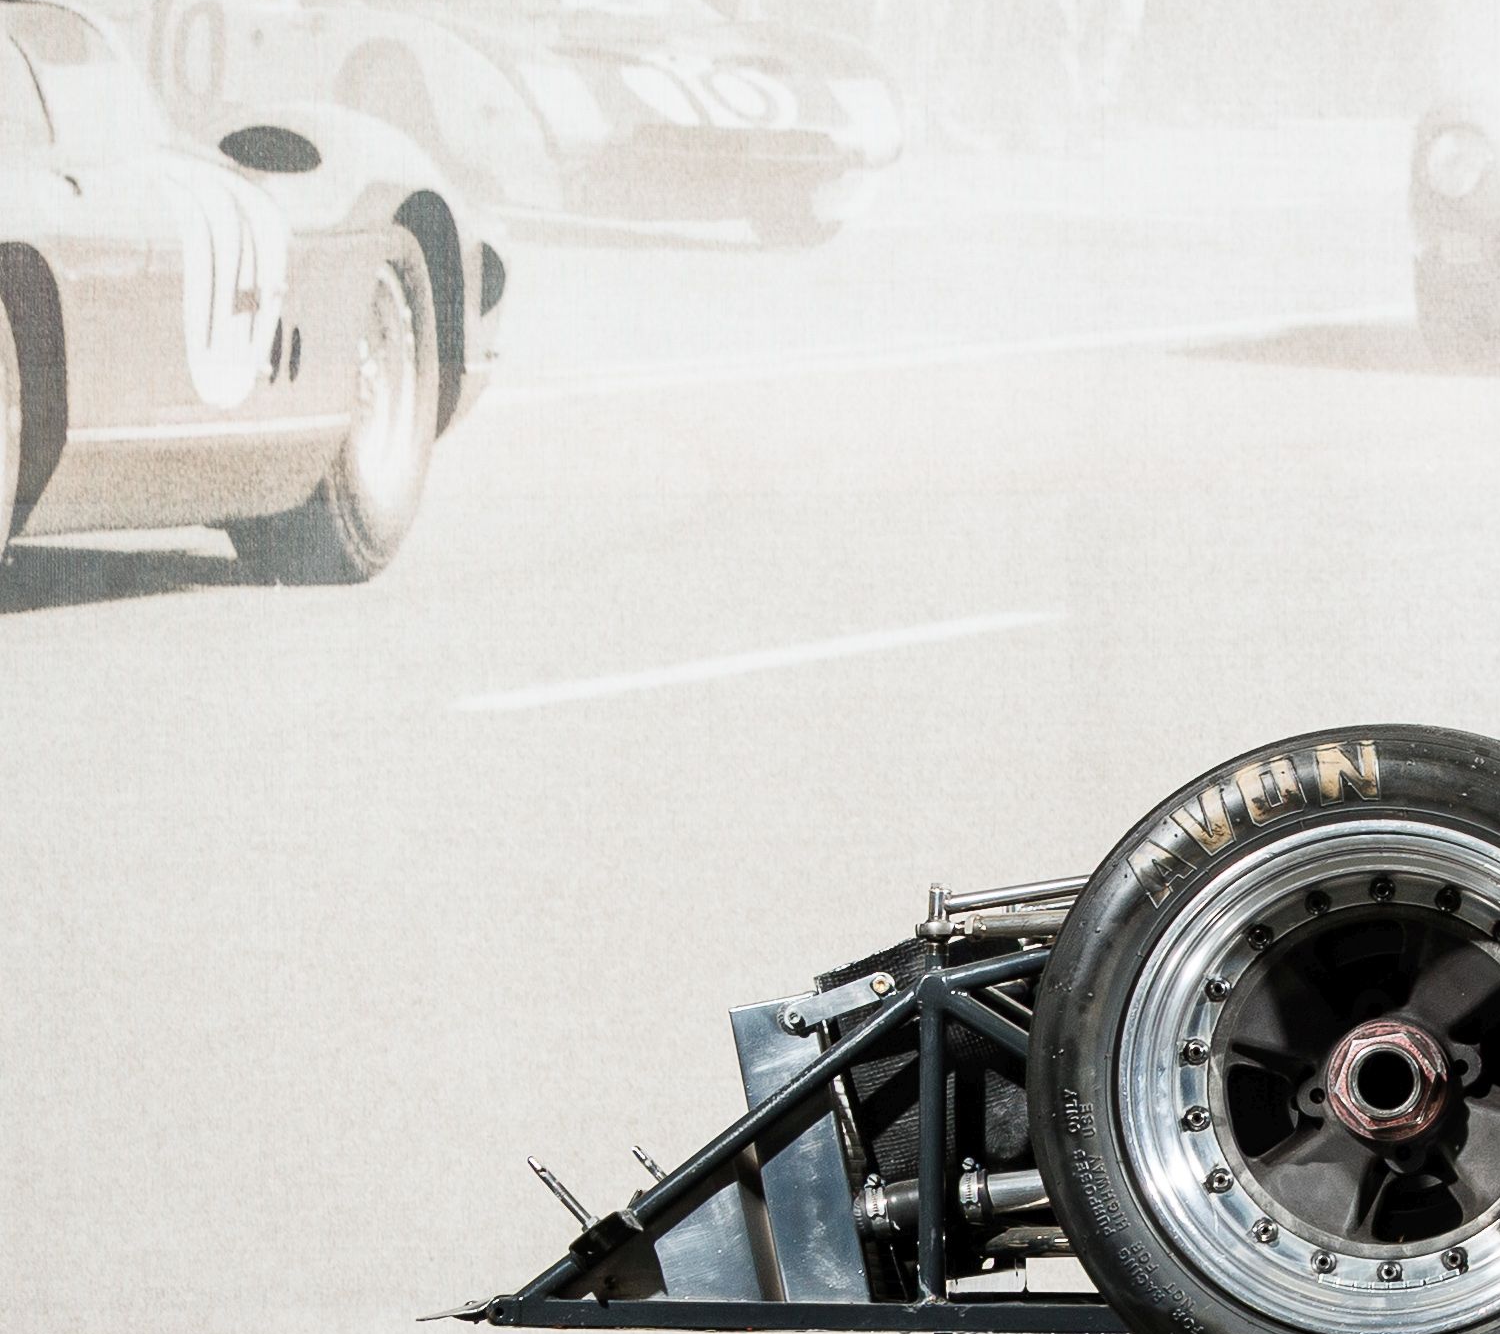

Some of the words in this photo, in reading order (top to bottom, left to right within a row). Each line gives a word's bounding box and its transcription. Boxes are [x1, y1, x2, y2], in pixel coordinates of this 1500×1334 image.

[1127, 739, 1382, 909] AVON
[1064, 1087, 1080, 1134] ONLY
[1080, 1102, 1096, 1139] USE
[1130, 1240, 1160, 1273] FOR
[1164, 1281, 1197, 1312] NOT
